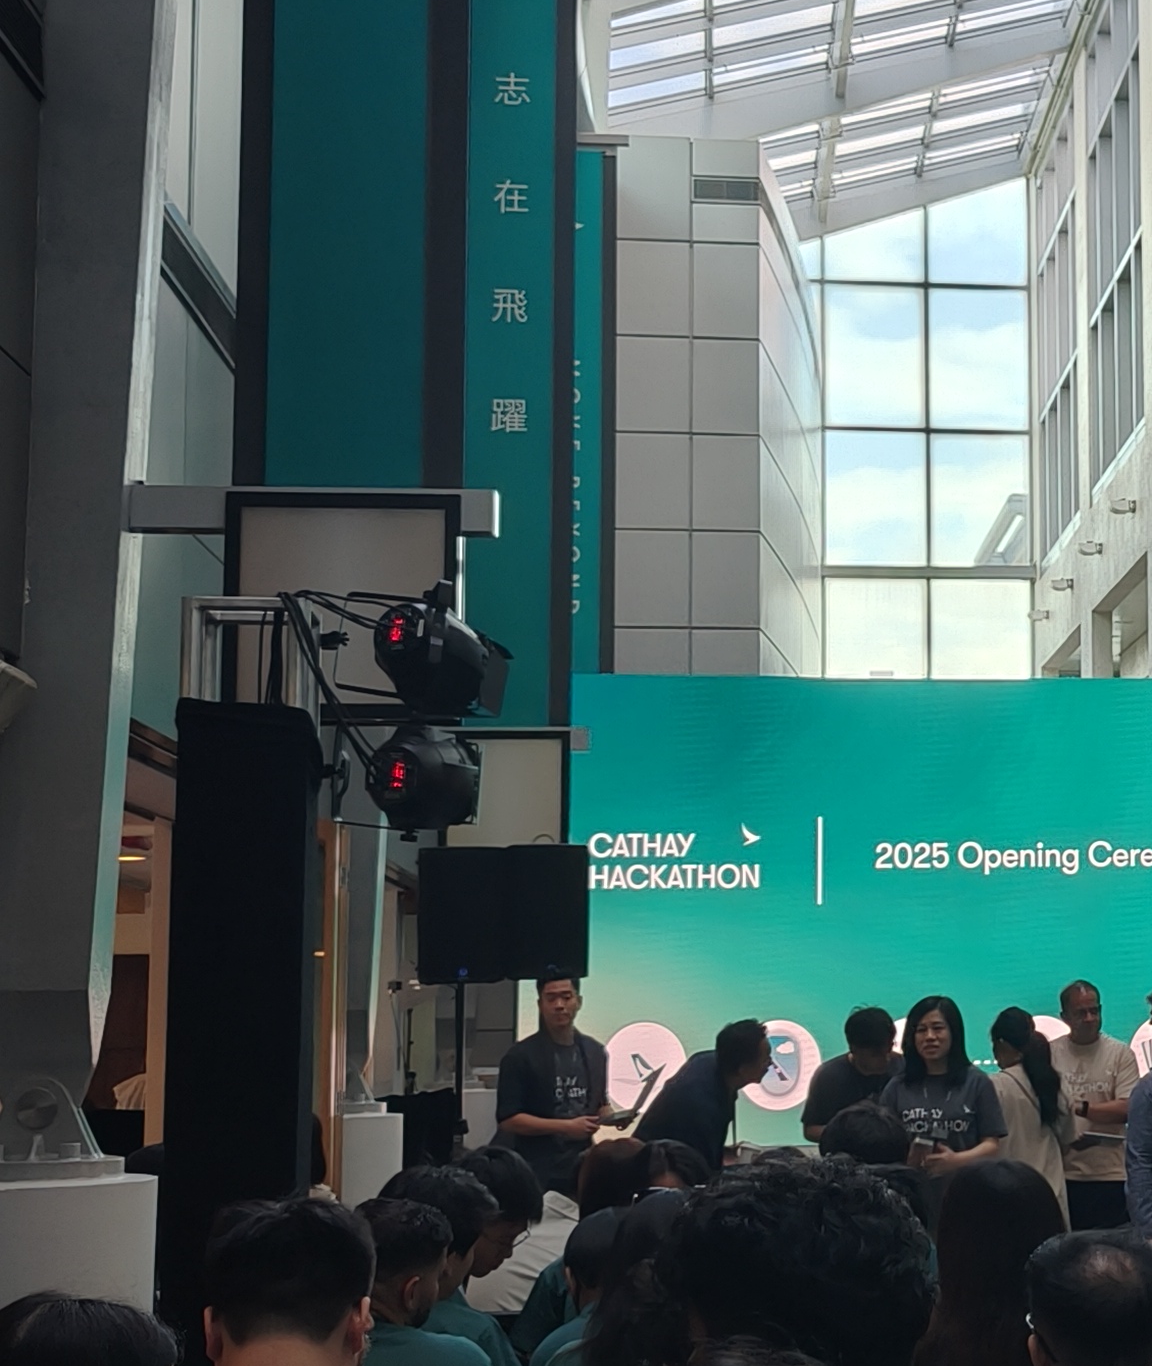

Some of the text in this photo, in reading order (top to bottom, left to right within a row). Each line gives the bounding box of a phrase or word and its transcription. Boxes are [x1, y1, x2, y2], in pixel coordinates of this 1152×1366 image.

[491, 72, 530, 434] 志在飛躍
[588, 832, 697, 859] CATHAY
[875, 842, 950, 869] 2025
[957, 841, 1080, 875] Opening
[588, 863, 761, 890] HACKATHON
